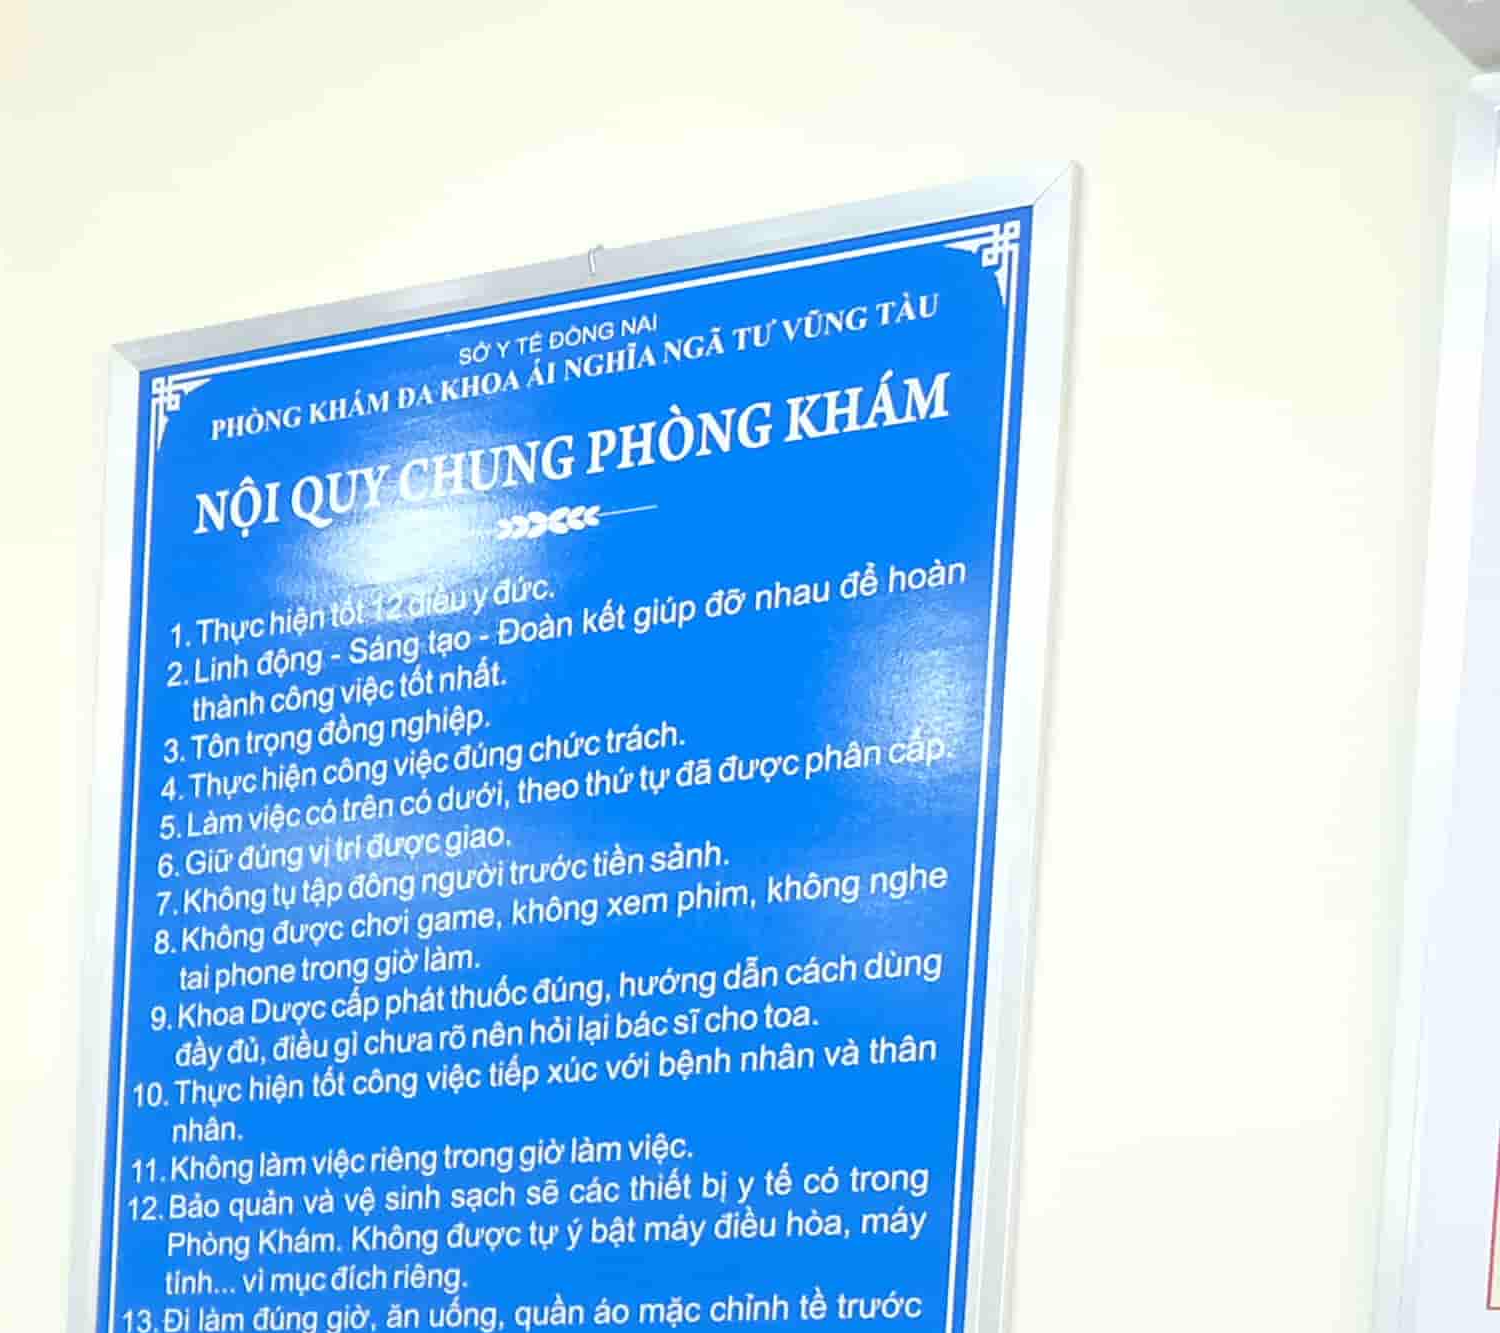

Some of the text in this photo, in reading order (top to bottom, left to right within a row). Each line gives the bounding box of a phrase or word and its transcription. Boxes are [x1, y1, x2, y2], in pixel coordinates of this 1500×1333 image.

[209, 289, 941, 442] PHÒNG KHÁM ĐA KHOA ÁI NGHĨA NGÃ TƯ VŨNG TÀU
[457, 310, 658, 367] SỞ Y TẾ ĐỒNG NAI
[191, 366, 952, 539] NỘI QUY CHUNG PHÒNG KHÁM
[164, 659, 190, 689] 2.
[192, 651, 250, 685] Linh
[255, 646, 324, 679] động
[346, 633, 420, 665] Sáng
[426, 628, 473, 658] tạo
[495, 611, 574, 646] Đoàn
[581, 596, 627, 636] kết
[631, 593, 698, 636] giúp
[702, 586, 749, 619] đỡ
[753, 578, 832, 612] nhau
[838, 559, 880, 600] để
[886, 556, 967, 594] hoàn
[163, 702, 493, 765] 3. Tôn trọng đồng nghiệp.
[190, 653, 509, 723] thành công việc tốt nhất.
